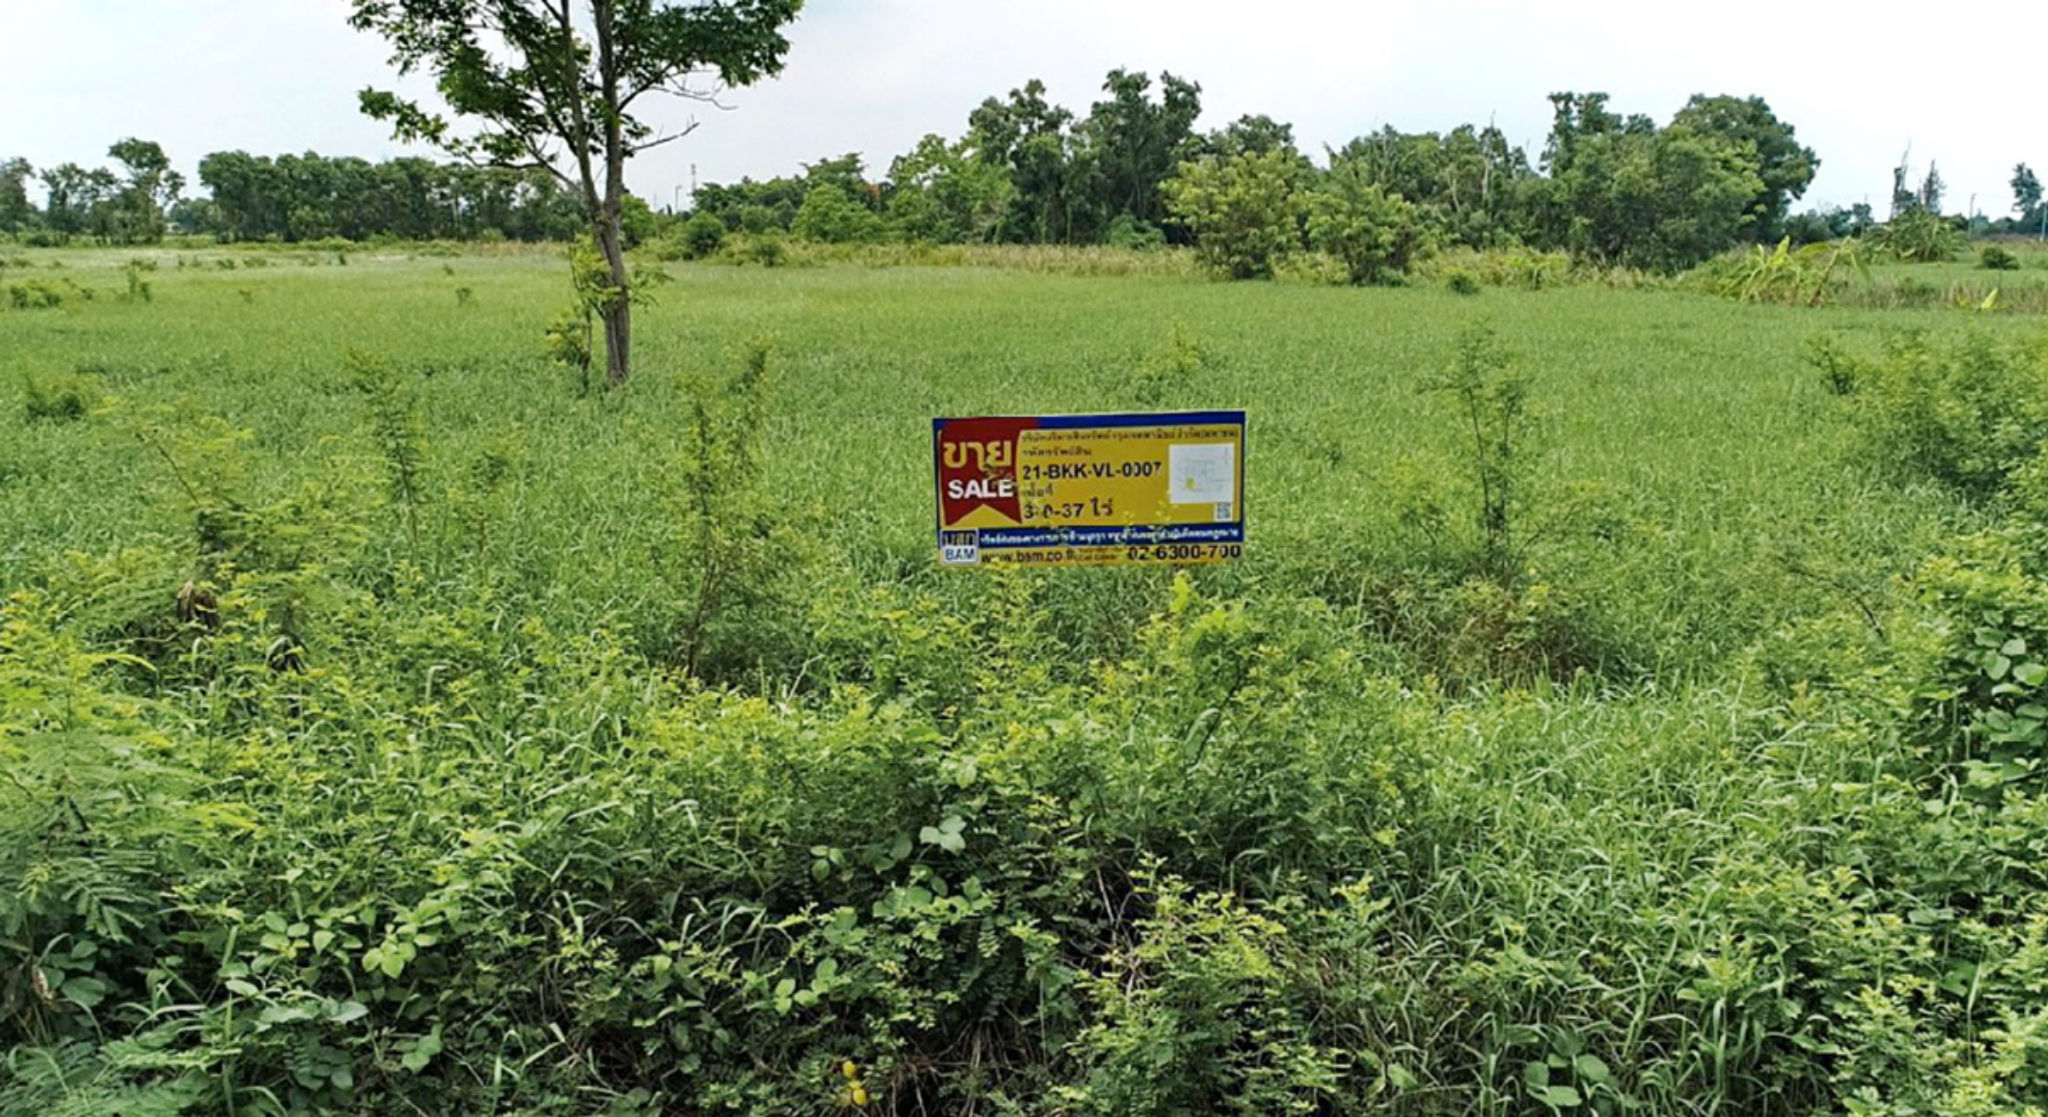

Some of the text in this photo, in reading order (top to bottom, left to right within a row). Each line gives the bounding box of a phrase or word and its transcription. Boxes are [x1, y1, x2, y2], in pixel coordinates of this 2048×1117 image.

[943, 440, 1012, 471] ขาย
[948, 479, 1014, 499] SALE
[1090, 497, 1113, 516] ไร่
[946, 549, 974, 560] BAM
[1128, 545, 1241, 560] 02-6300-700
